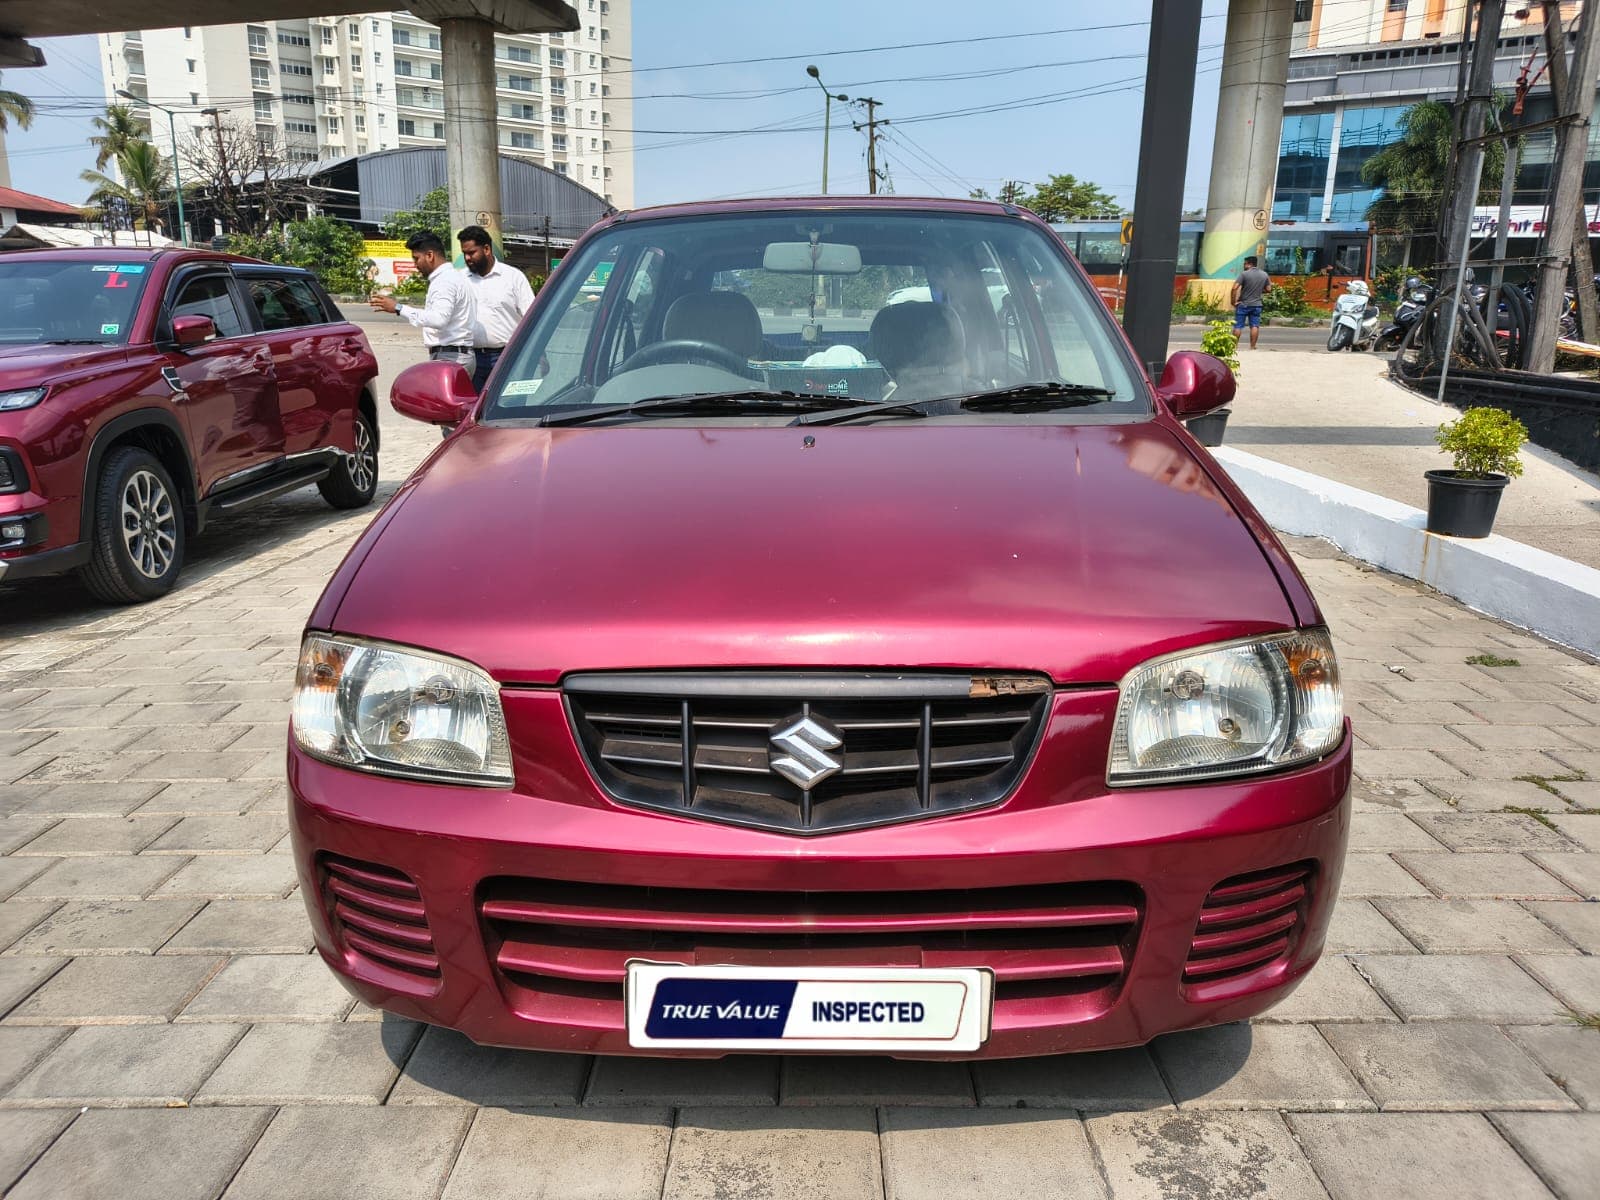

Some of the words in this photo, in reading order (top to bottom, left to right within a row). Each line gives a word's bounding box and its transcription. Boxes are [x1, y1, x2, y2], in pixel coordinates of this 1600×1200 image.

[104, 273, 128, 287] L
[662, 1004, 712, 1019] TRUE
[716, 1000, 780, 1019] VALUE
[812, 1001, 925, 1022] INSPECTED
